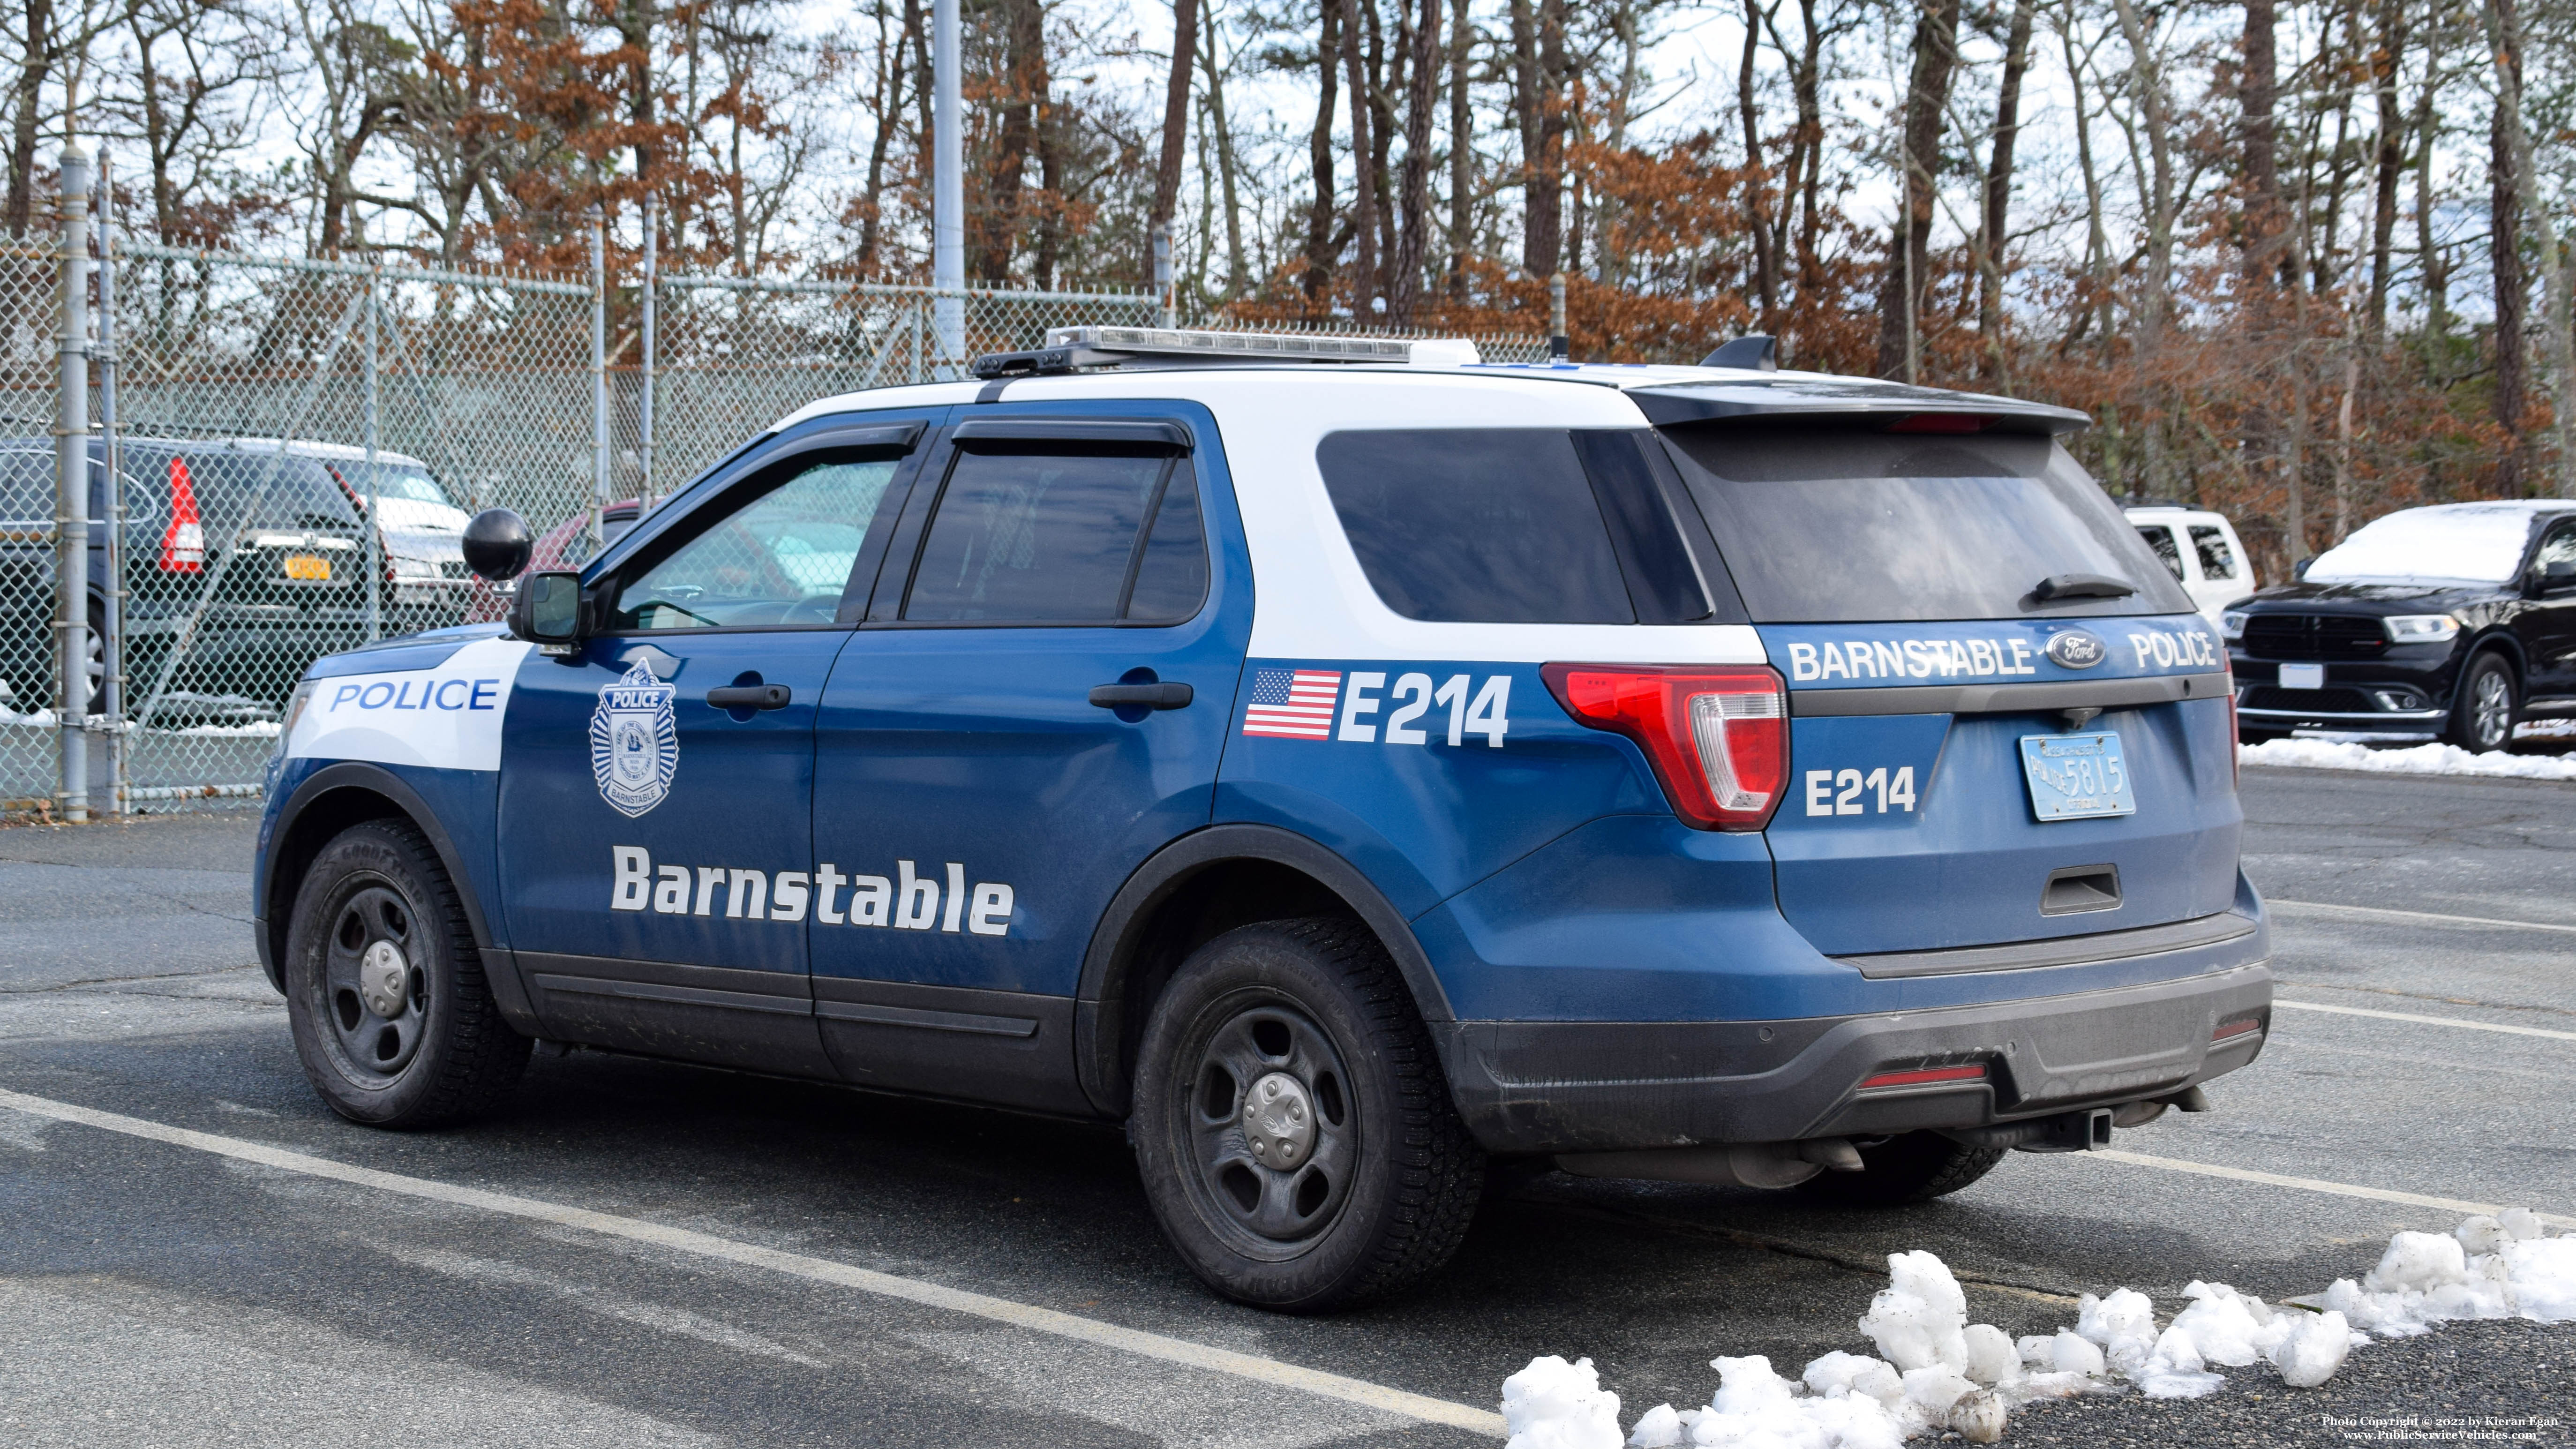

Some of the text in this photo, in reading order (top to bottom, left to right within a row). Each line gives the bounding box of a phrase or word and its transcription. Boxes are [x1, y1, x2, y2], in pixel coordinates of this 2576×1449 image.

[1788, 639, 2035, 681] BARNSTABLE
[2065, 637, 2095, 660] Ford
[2127, 631, 2217, 668] POLICE
[329, 679, 500, 712] POLICE
[612, 691, 659, 708] POLICE
[1337, 672, 1512, 747] E214
[1806, 766, 1915, 816] E214
[2064, 757, 2123, 796] 5815
[611, 789, 656, 804] BARNSTABLE
[611, 846, 1014, 935] Barnstable
